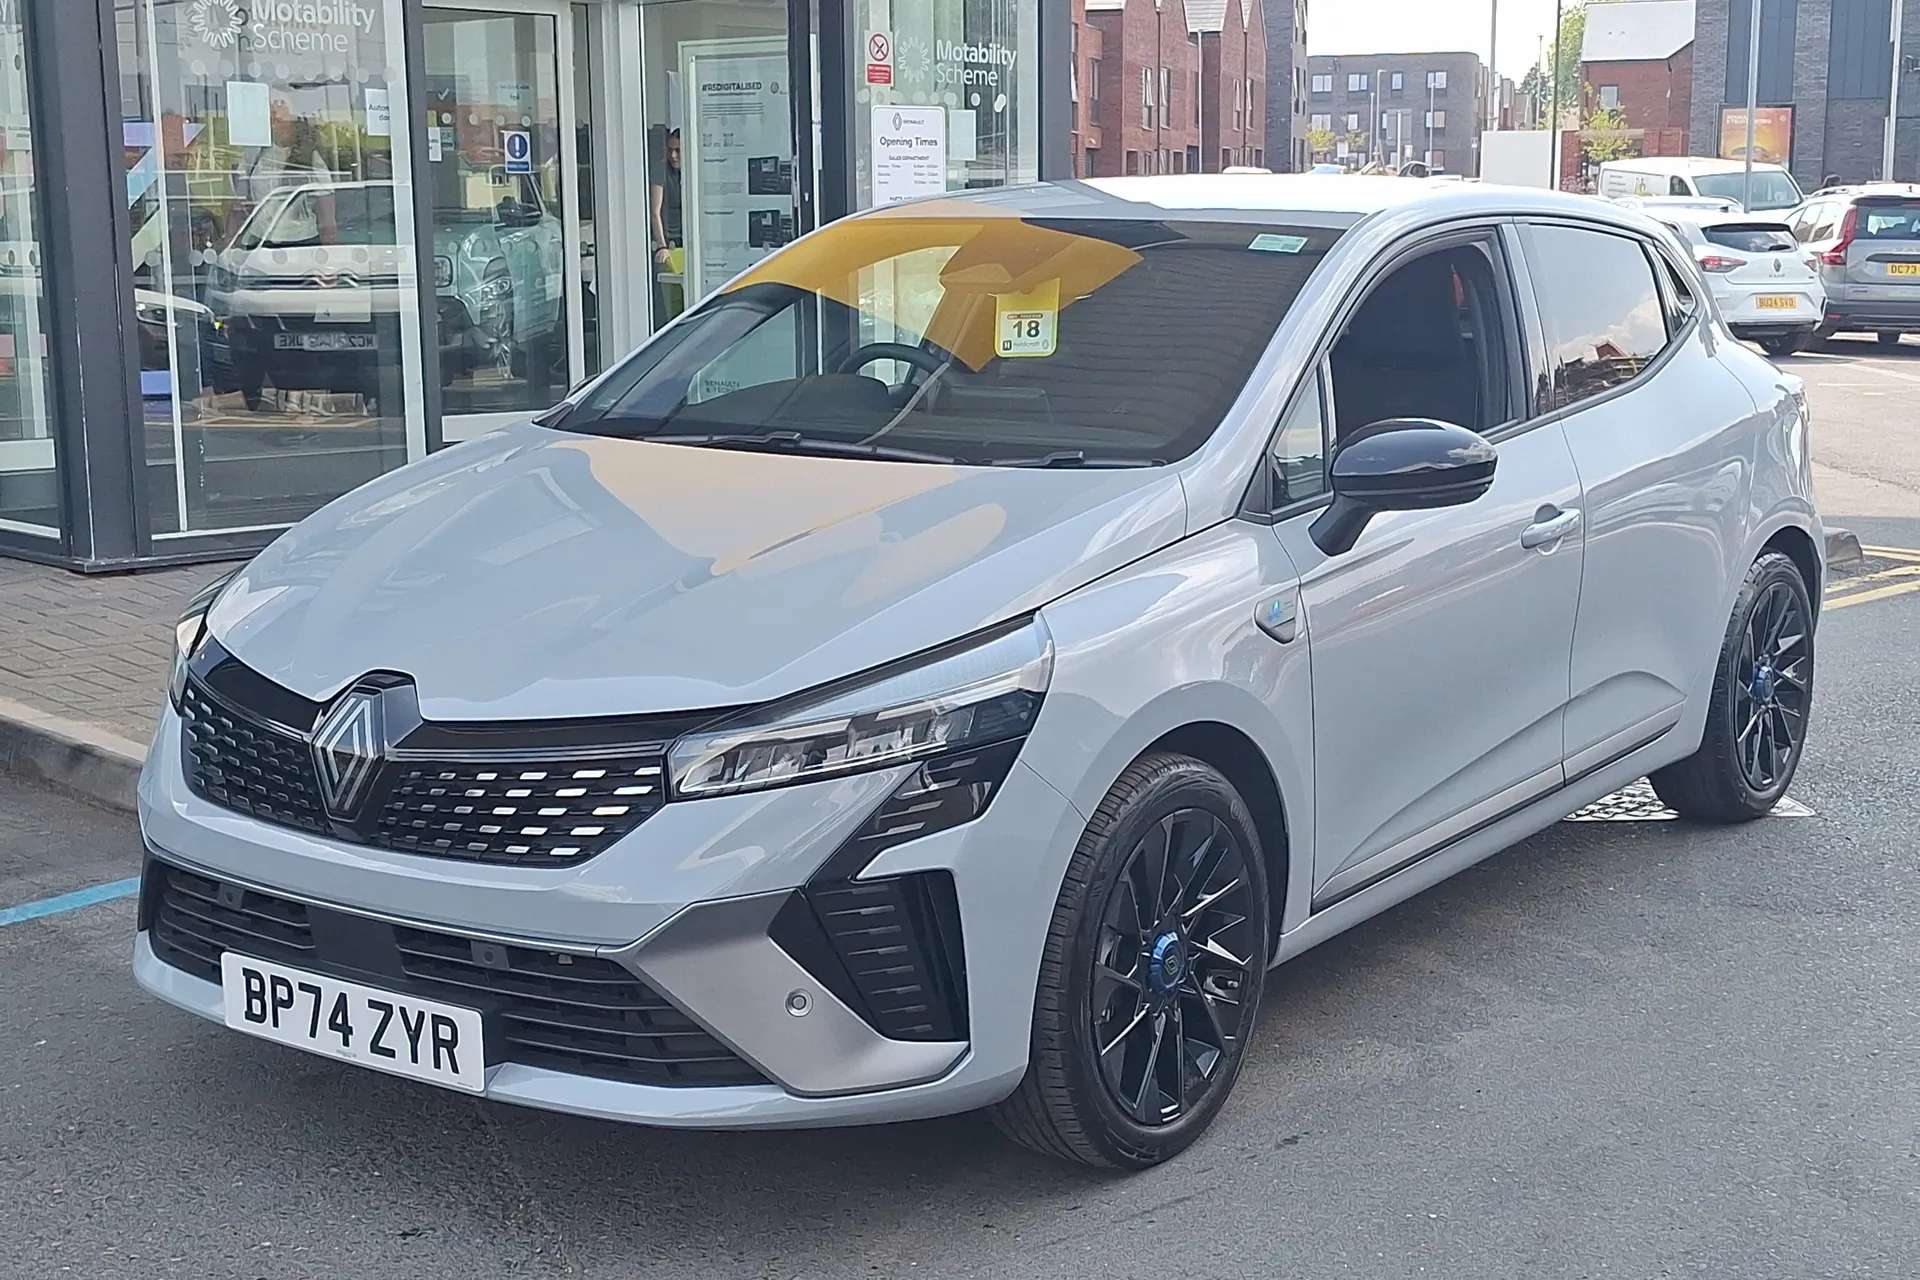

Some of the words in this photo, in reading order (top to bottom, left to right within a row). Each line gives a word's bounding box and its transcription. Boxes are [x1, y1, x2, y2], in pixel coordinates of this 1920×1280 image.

[251, 0, 375, 33] Motability
[252, 23, 349, 52] Scheme
[936, 39, 1017, 71] Motability
[936, 62, 999, 87] Scheme
[880, 136, 913, 149] Opening
[915, 137, 938, 147] Times
[1890, 264, 1917, 275] DC73
[1012, 320, 1041, 339] 18
[242, 967, 354, 1048] BP74
[367, 998, 461, 1075] ZYR
